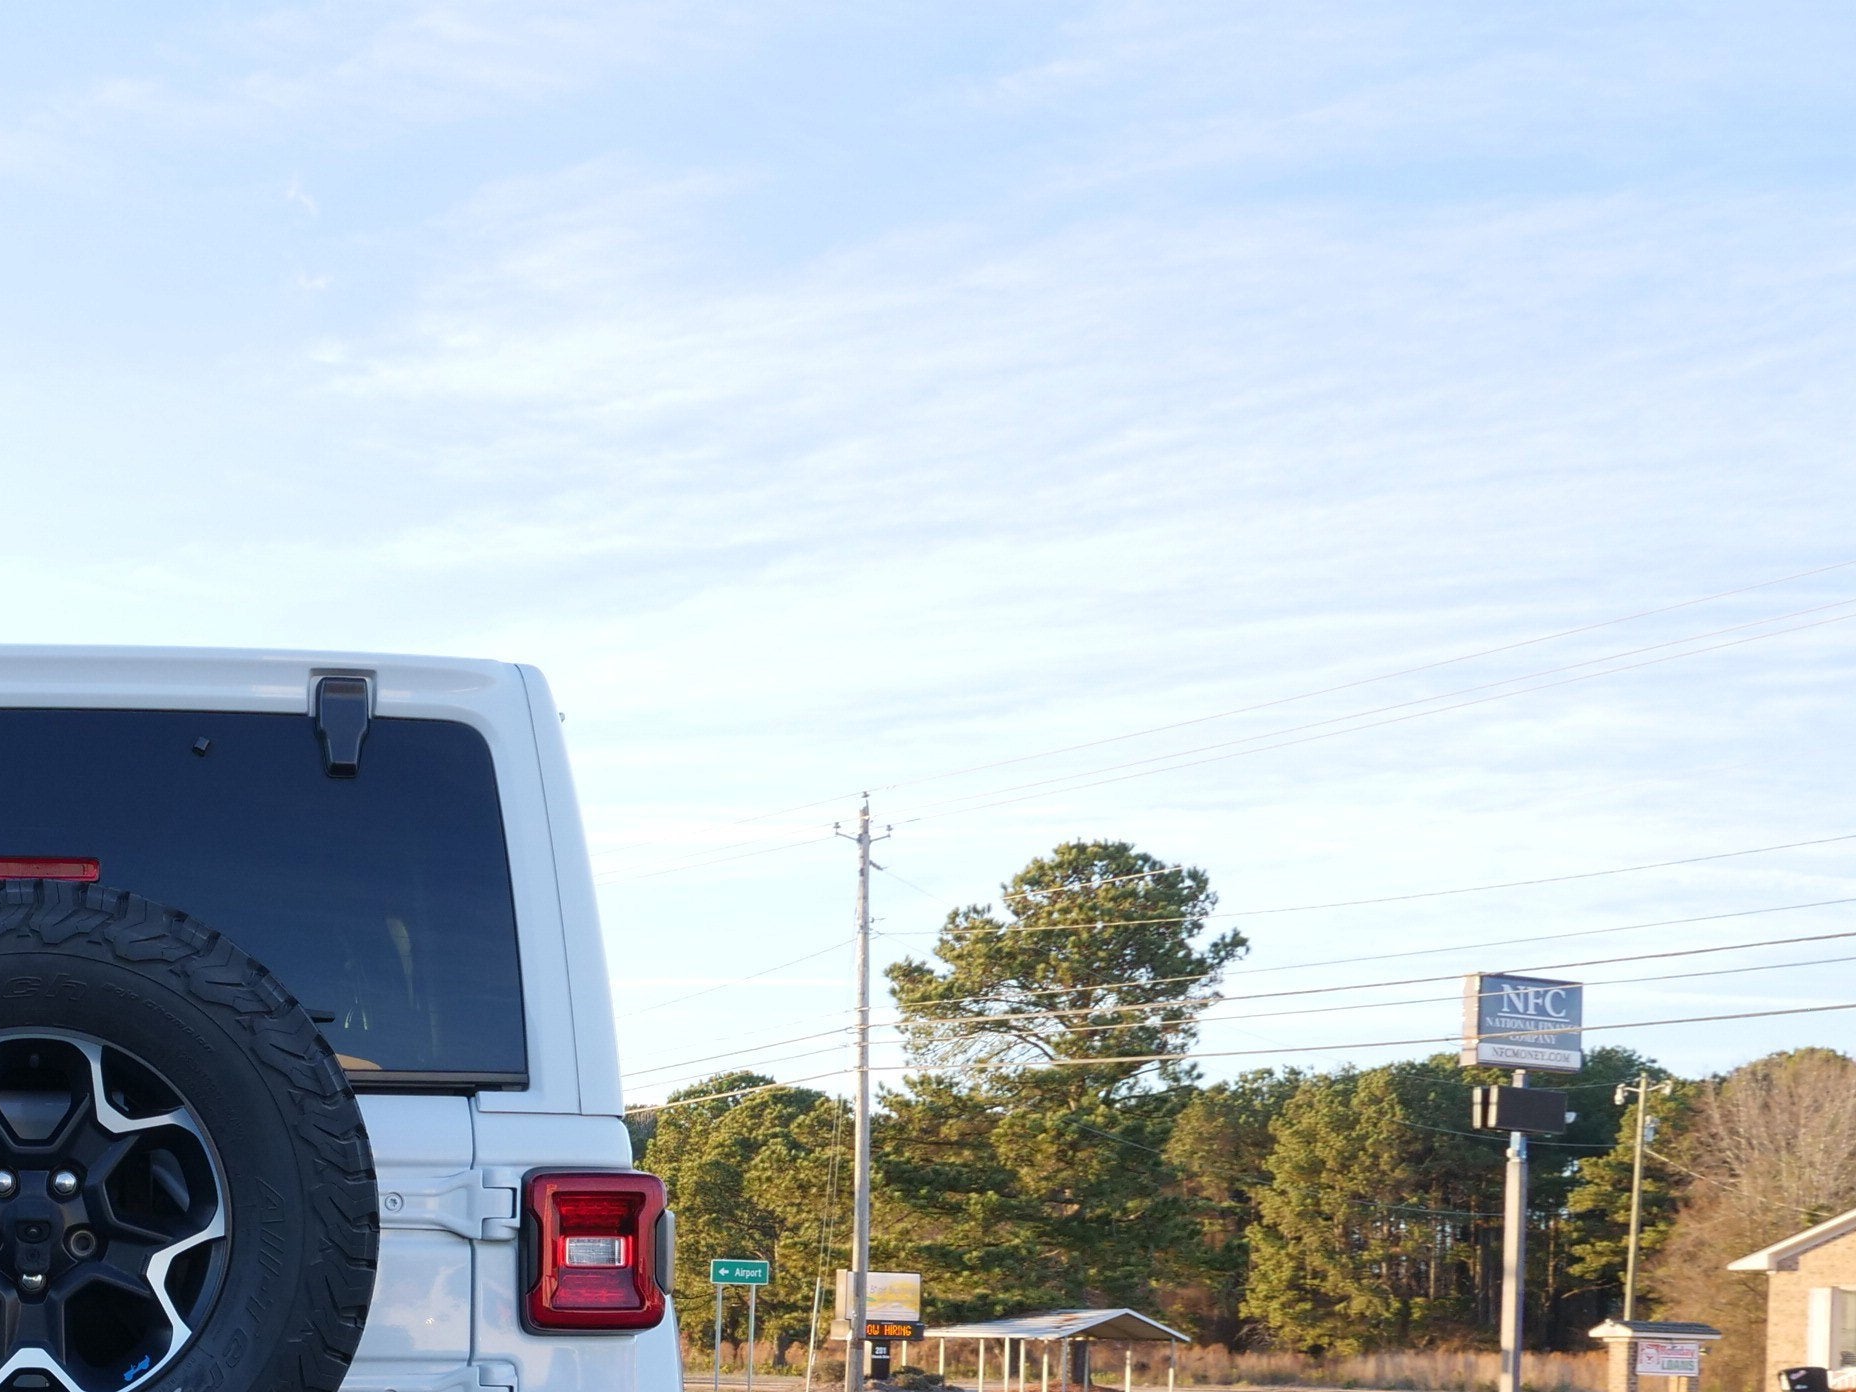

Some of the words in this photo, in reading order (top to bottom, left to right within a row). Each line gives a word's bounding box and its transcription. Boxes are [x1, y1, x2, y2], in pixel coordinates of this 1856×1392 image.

[1501, 984, 1566, 1017] NFC
[1486, 1017, 1535, 1030] NATIONAL
[734, 1267, 762, 1279] Airport
[866, 1324, 880, 1335] OW
[884, 1324, 912, 1336] HIRING
